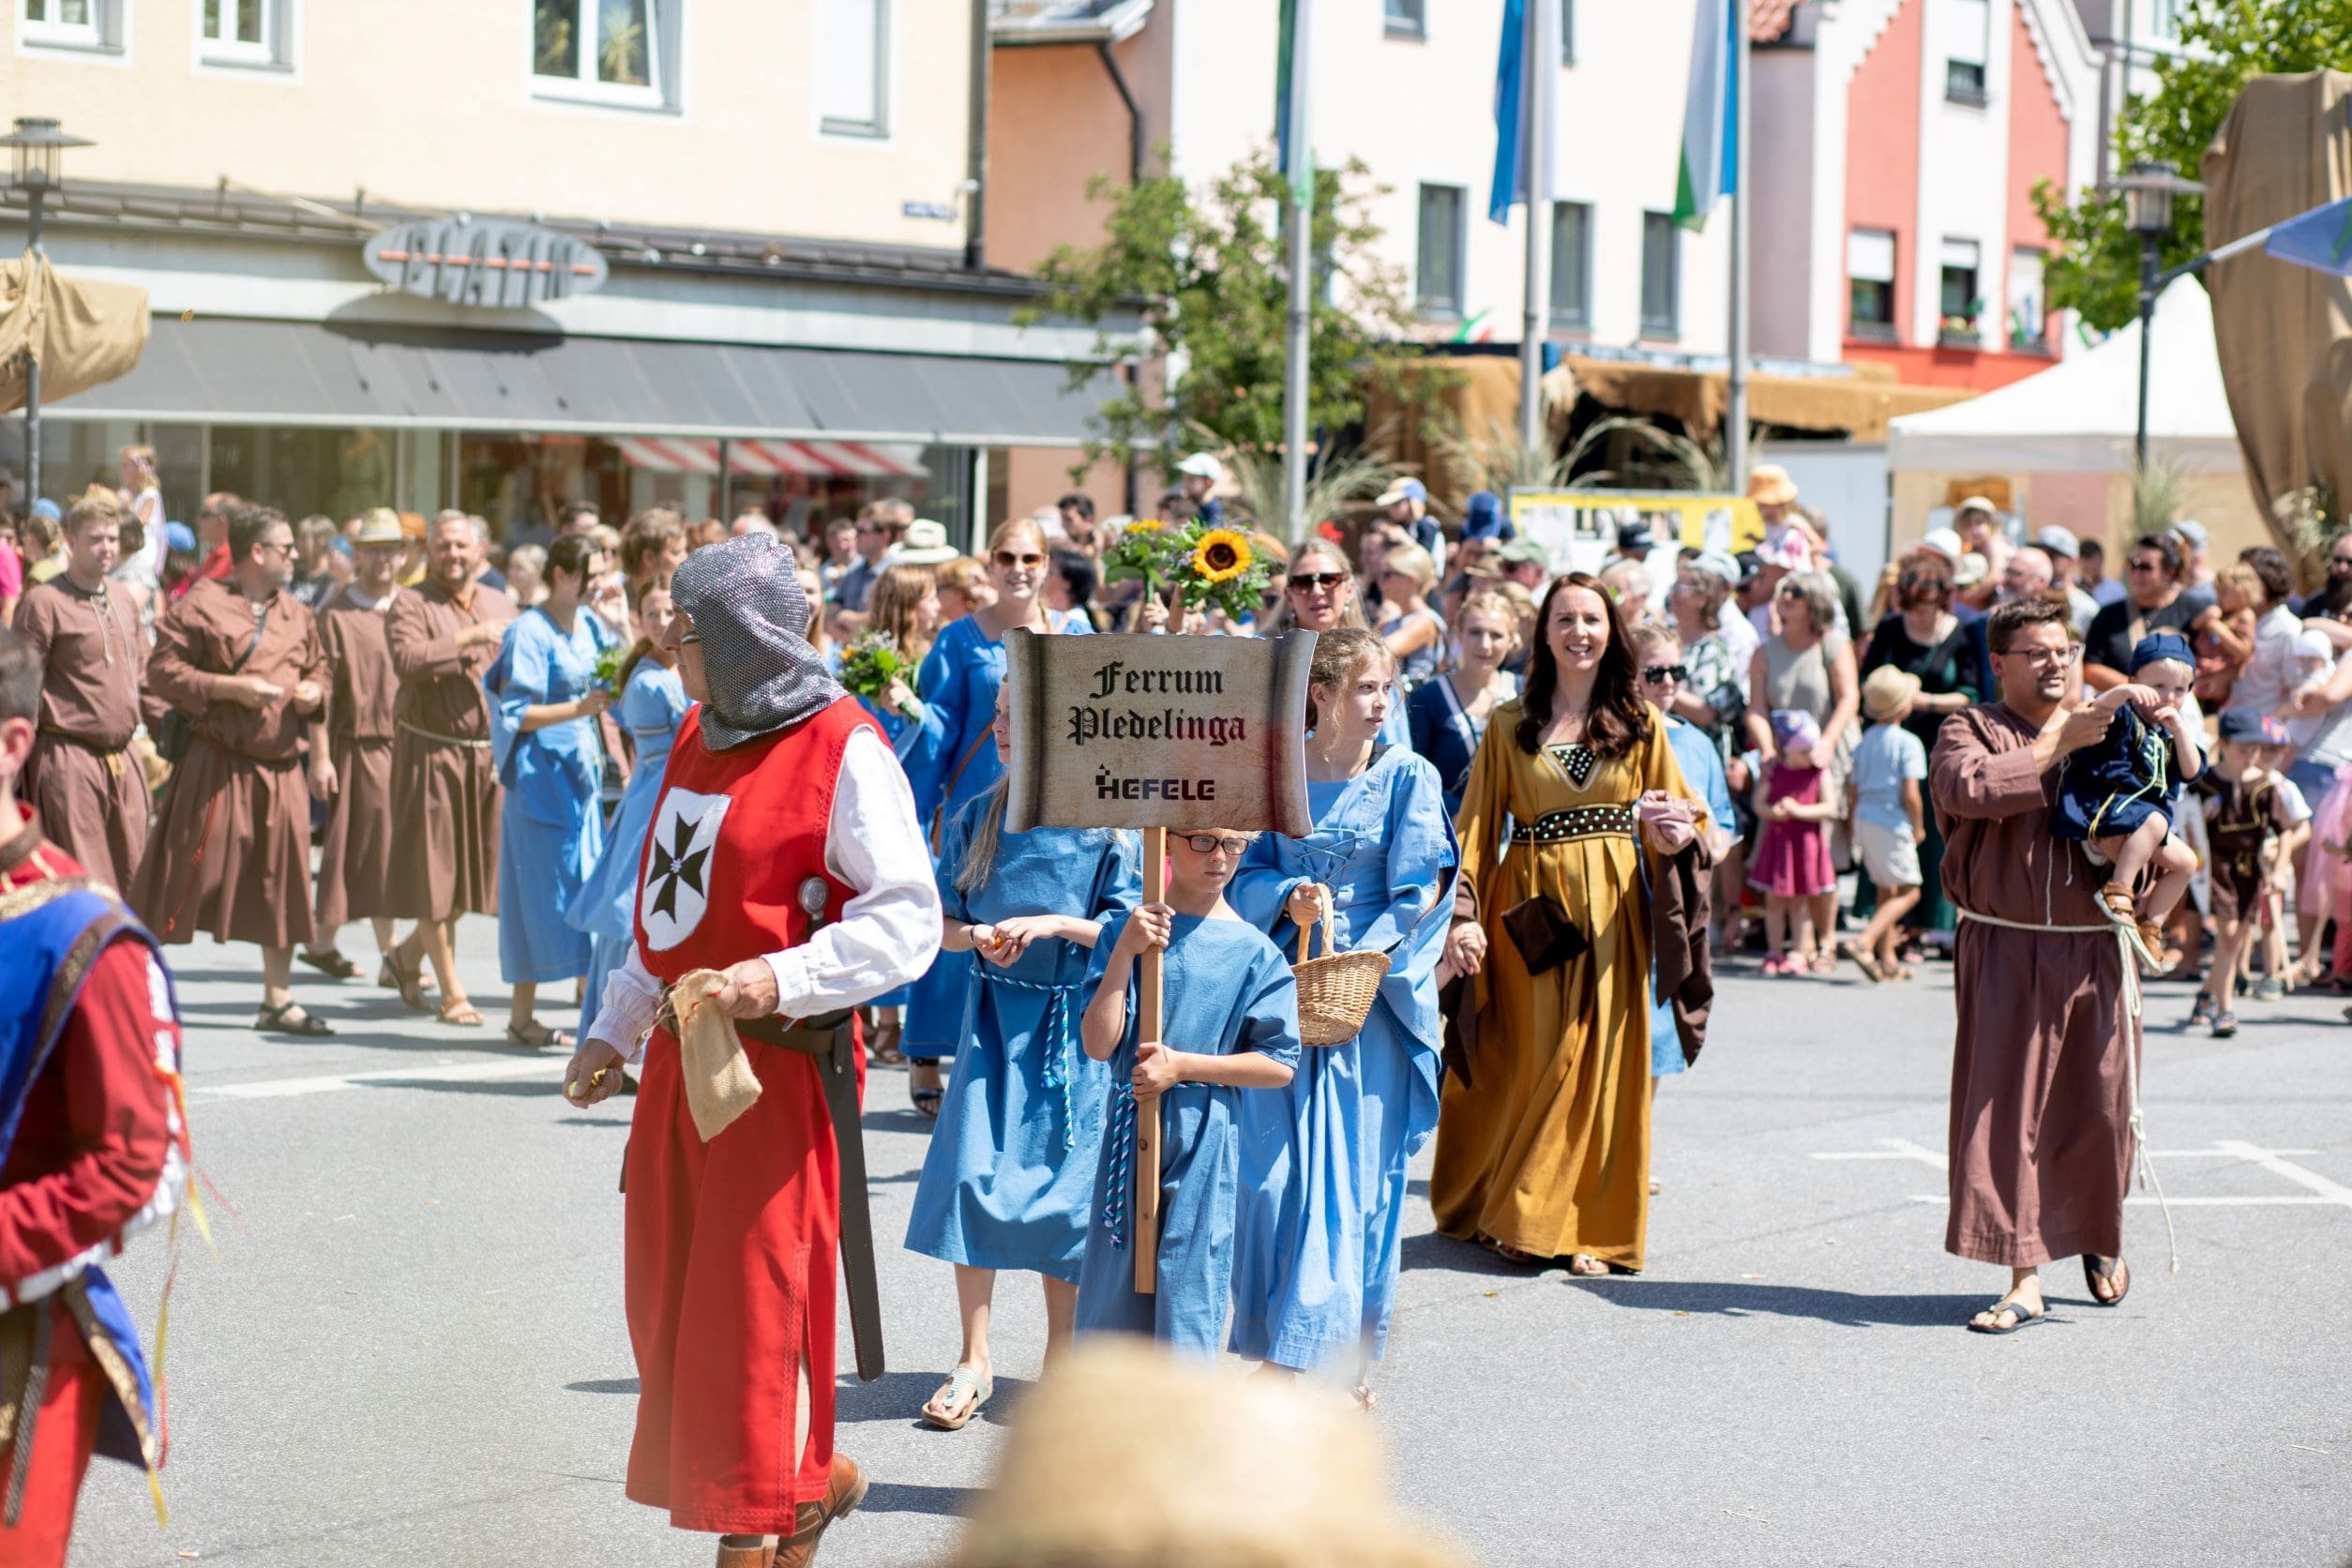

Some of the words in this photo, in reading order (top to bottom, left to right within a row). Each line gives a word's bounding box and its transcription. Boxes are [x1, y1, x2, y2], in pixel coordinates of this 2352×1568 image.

[1089, 660, 1224, 699] Ferrum
[1066, 705, 1246, 746] Pledelinga
[1095, 773, 1215, 801] HEFELE
